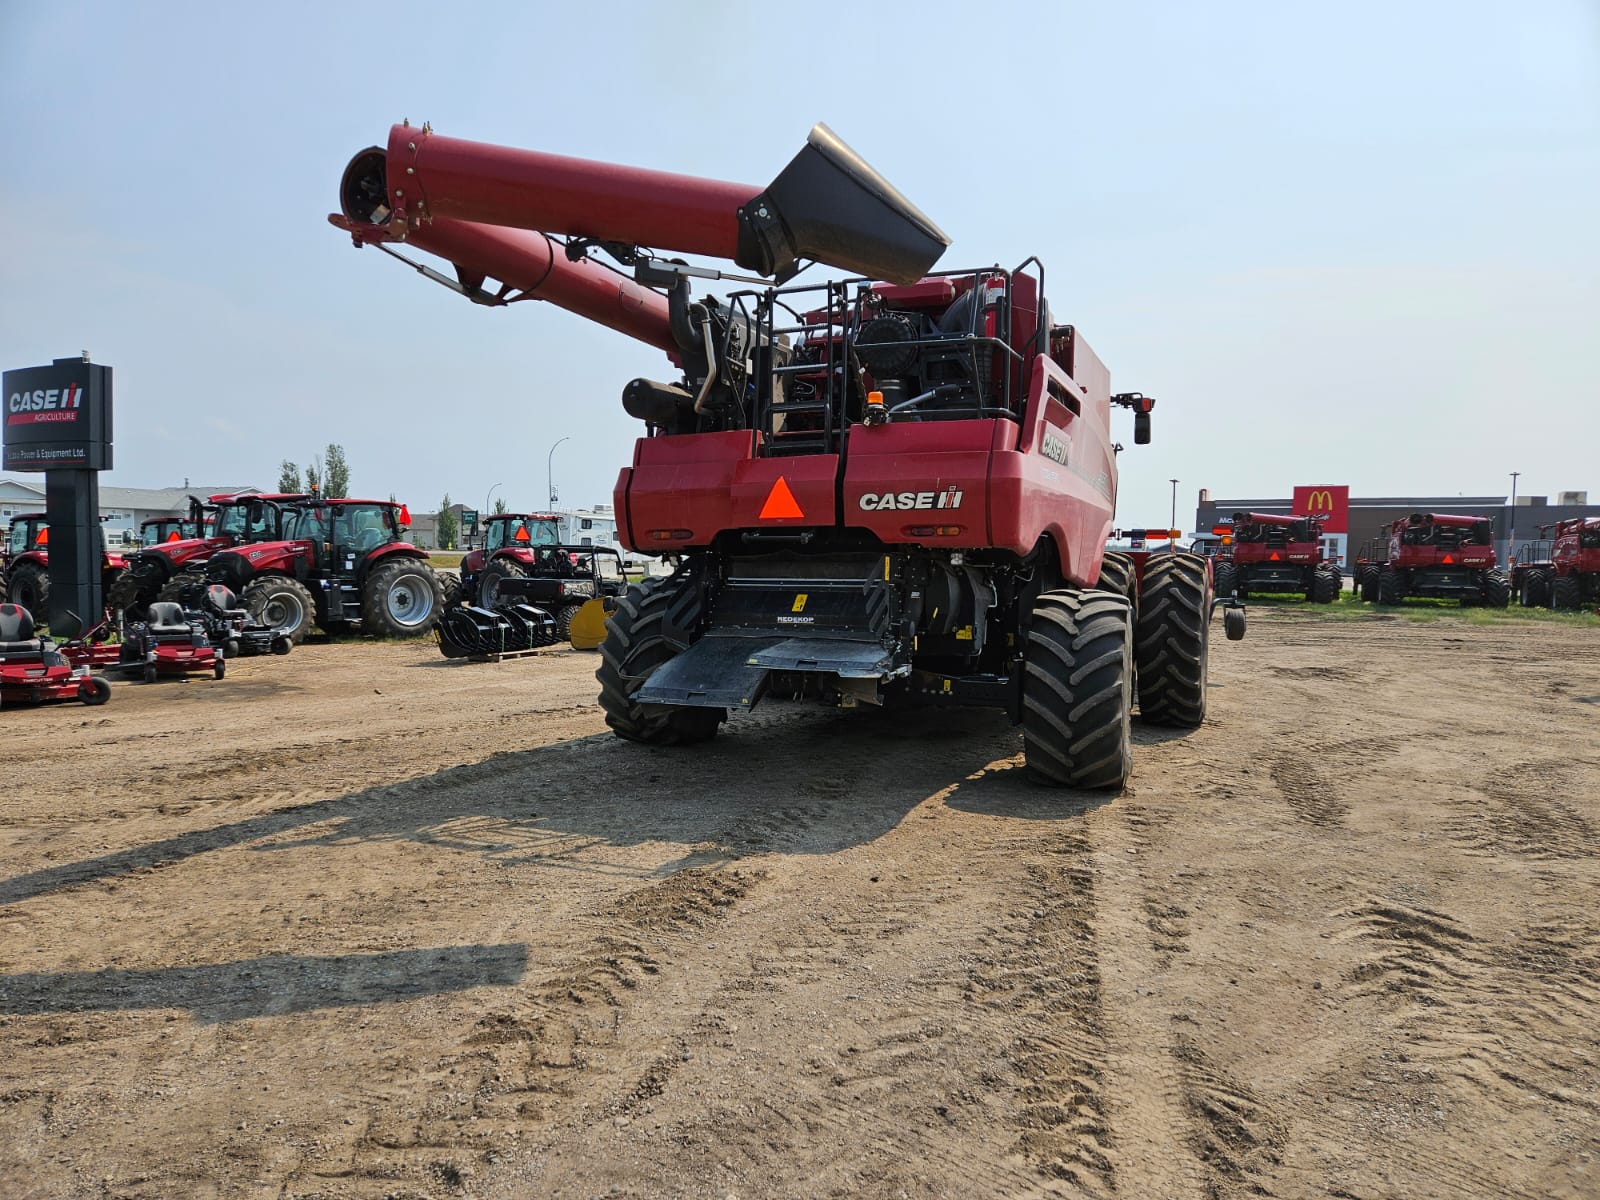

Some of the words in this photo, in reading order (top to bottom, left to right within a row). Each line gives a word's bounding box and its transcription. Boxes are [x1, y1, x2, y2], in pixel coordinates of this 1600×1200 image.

[9, 389, 59, 412] CASE
[34, 412, 76, 422] AGRICULTURE
[41, 448, 72, 459] Equipment
[72, 448, 86, 457] Ltd.
[859, 492, 935, 511] CASE
